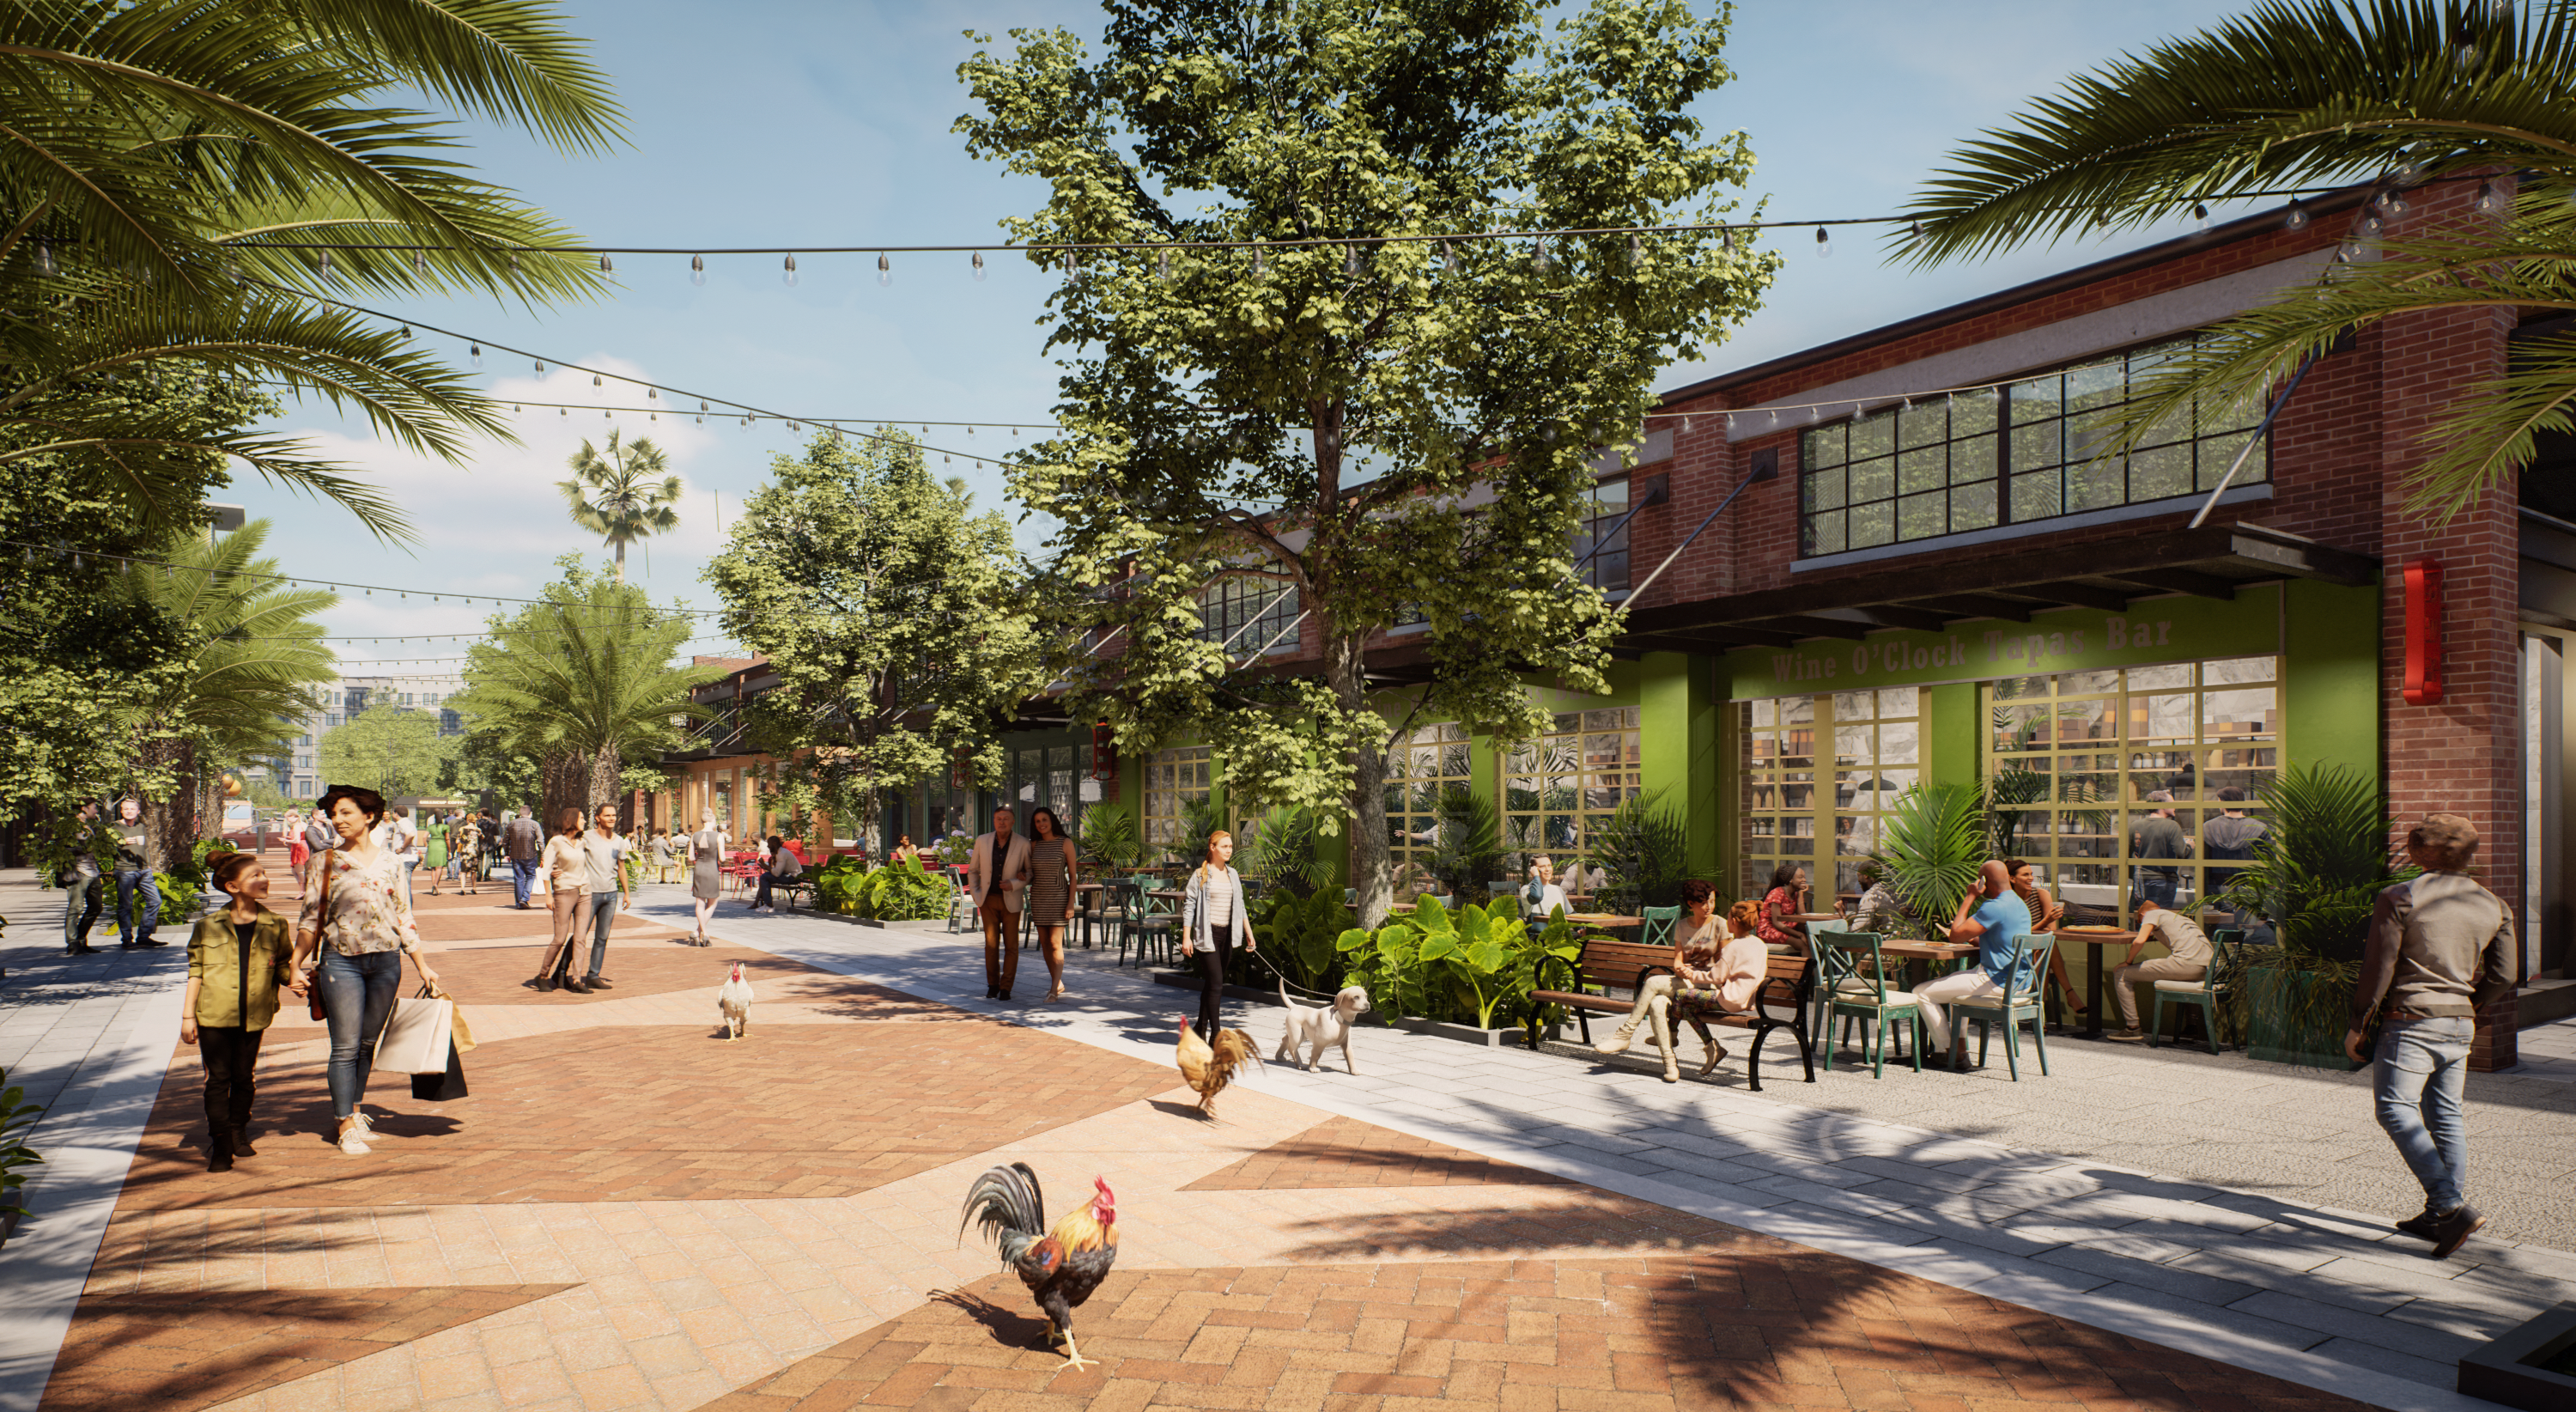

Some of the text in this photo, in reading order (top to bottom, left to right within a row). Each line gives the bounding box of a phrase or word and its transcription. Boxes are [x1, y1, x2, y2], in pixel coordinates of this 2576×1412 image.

[1771, 617, 2172, 683] Wine O'Clock Tapas Bar
